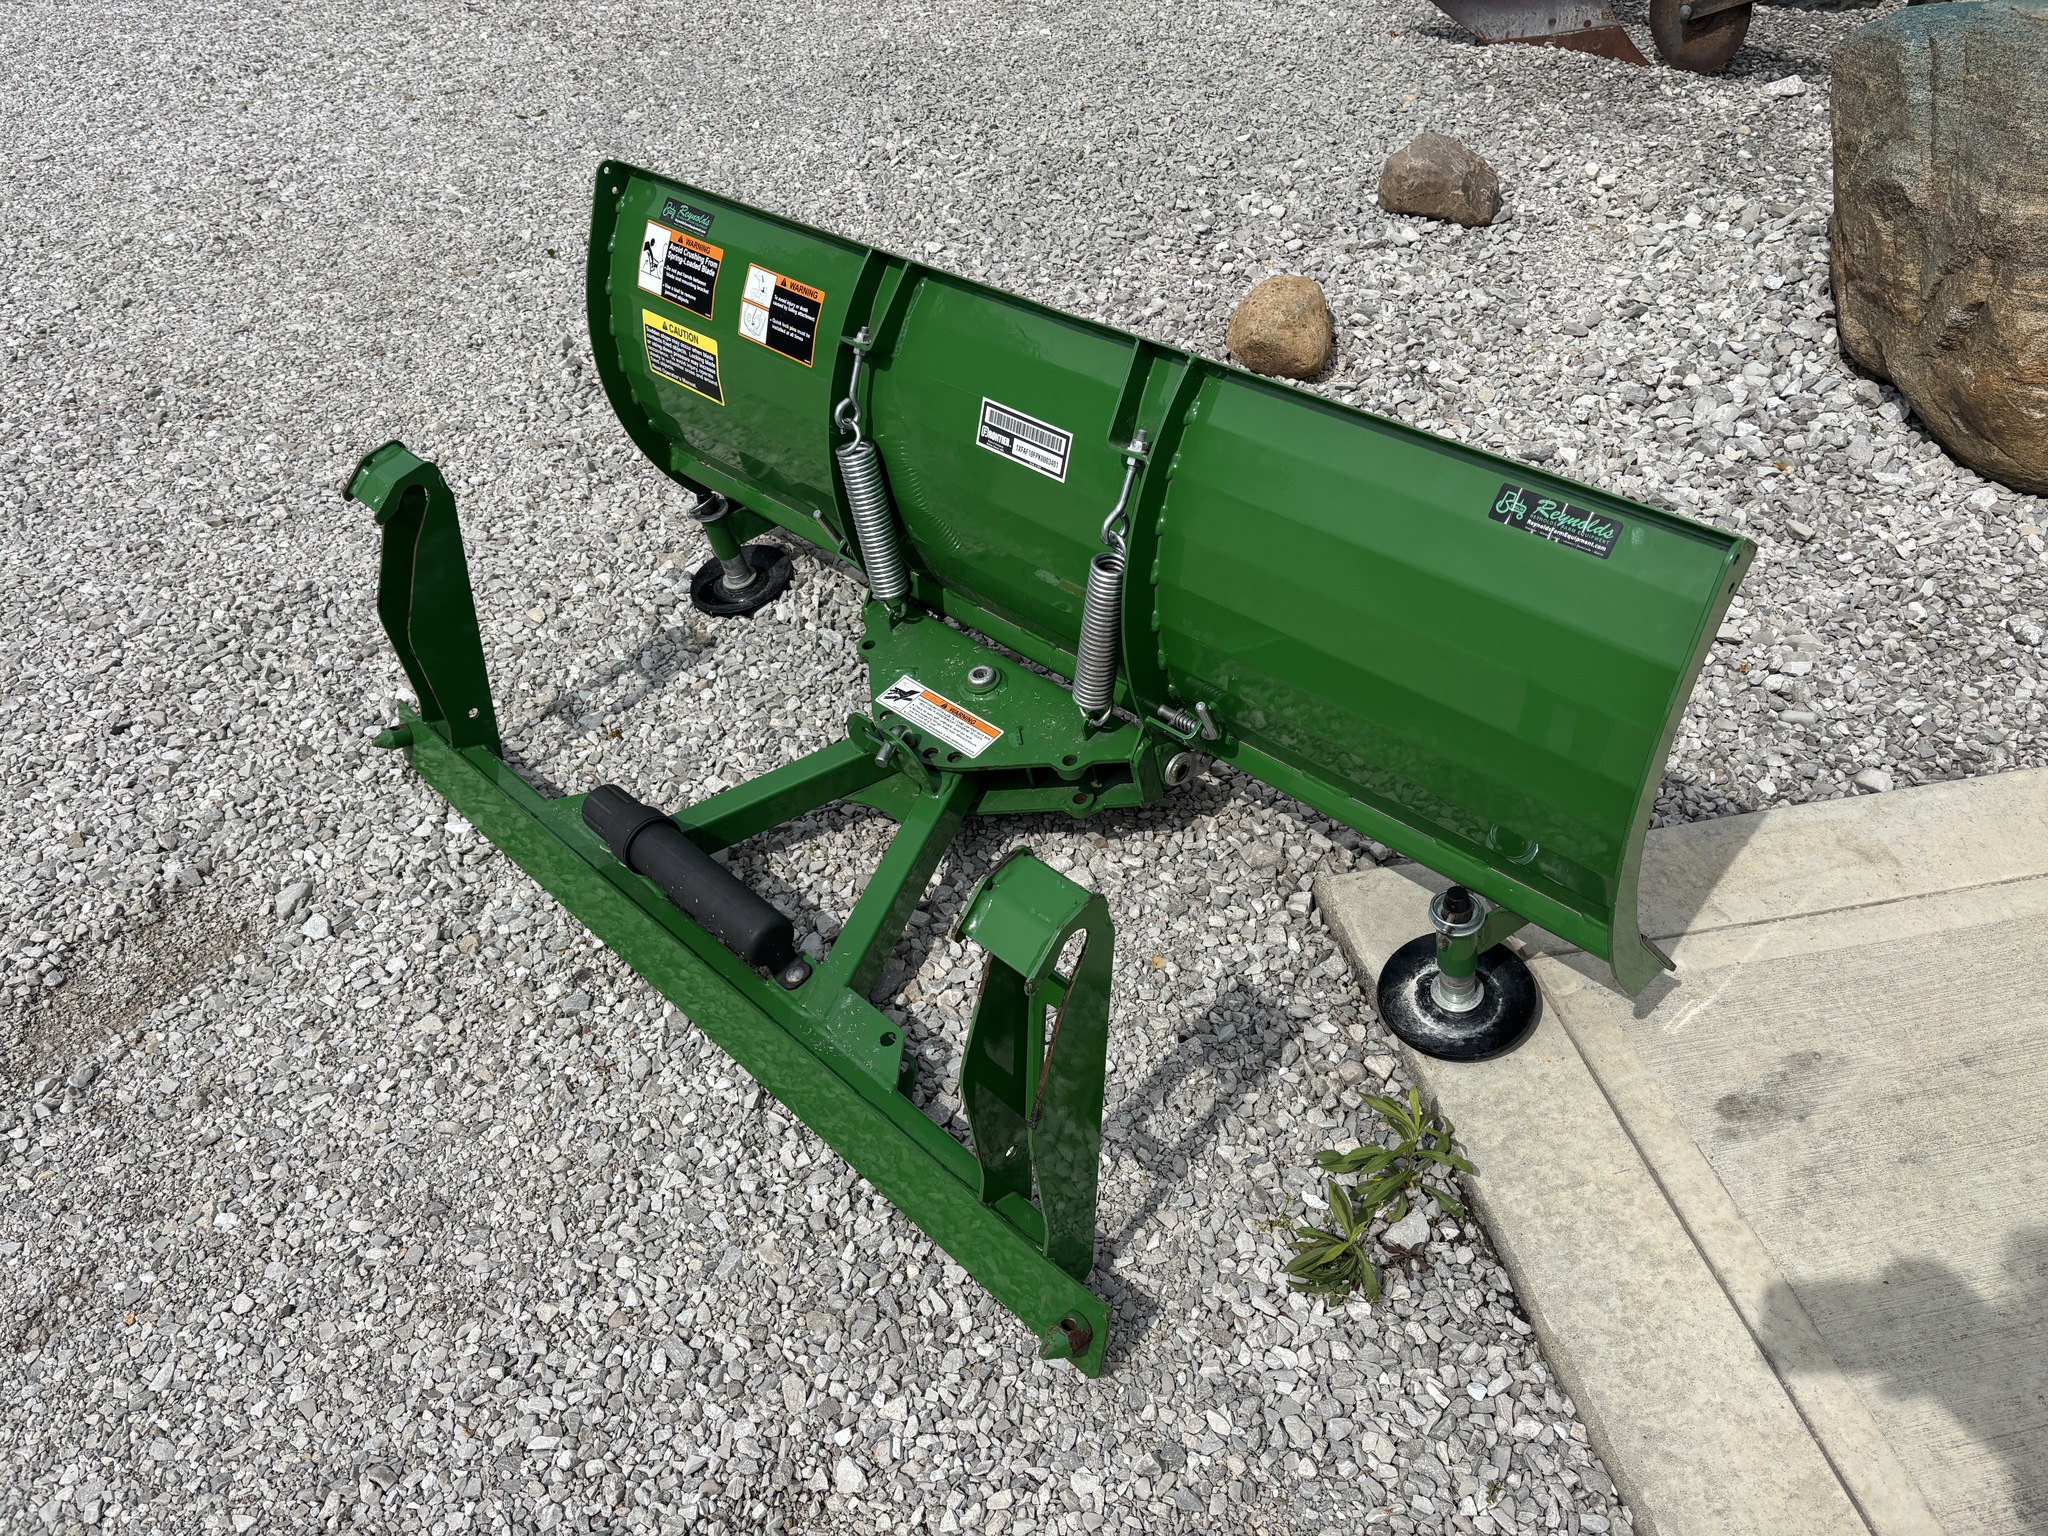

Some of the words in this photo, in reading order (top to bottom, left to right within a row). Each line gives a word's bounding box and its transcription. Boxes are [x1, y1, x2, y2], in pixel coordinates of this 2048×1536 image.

[677, 204, 710, 226] Reynolds
[668, 242, 684, 255] Avoid
[683, 248, 705, 265] Crushing
[704, 257, 718, 269] From
[685, 239, 711, 255] WARNING
[667, 250, 702, 271] Spring-Loaded
[701, 263, 716, 277] Blade
[789, 281, 819, 300] WARNING
[669, 323, 699, 345] CAUTION
[1529, 514, 1557, 526] REYNOLDS
[1560, 525, 1576, 533] FARM
[1577, 530, 1610, 545] EQUIPMENT
[1532, 499, 1614, 539] Reynolds
[1526, 519, 1607, 551] ReynoldsFarmEquipment.com
[948, 706, 977, 725] WARNING
